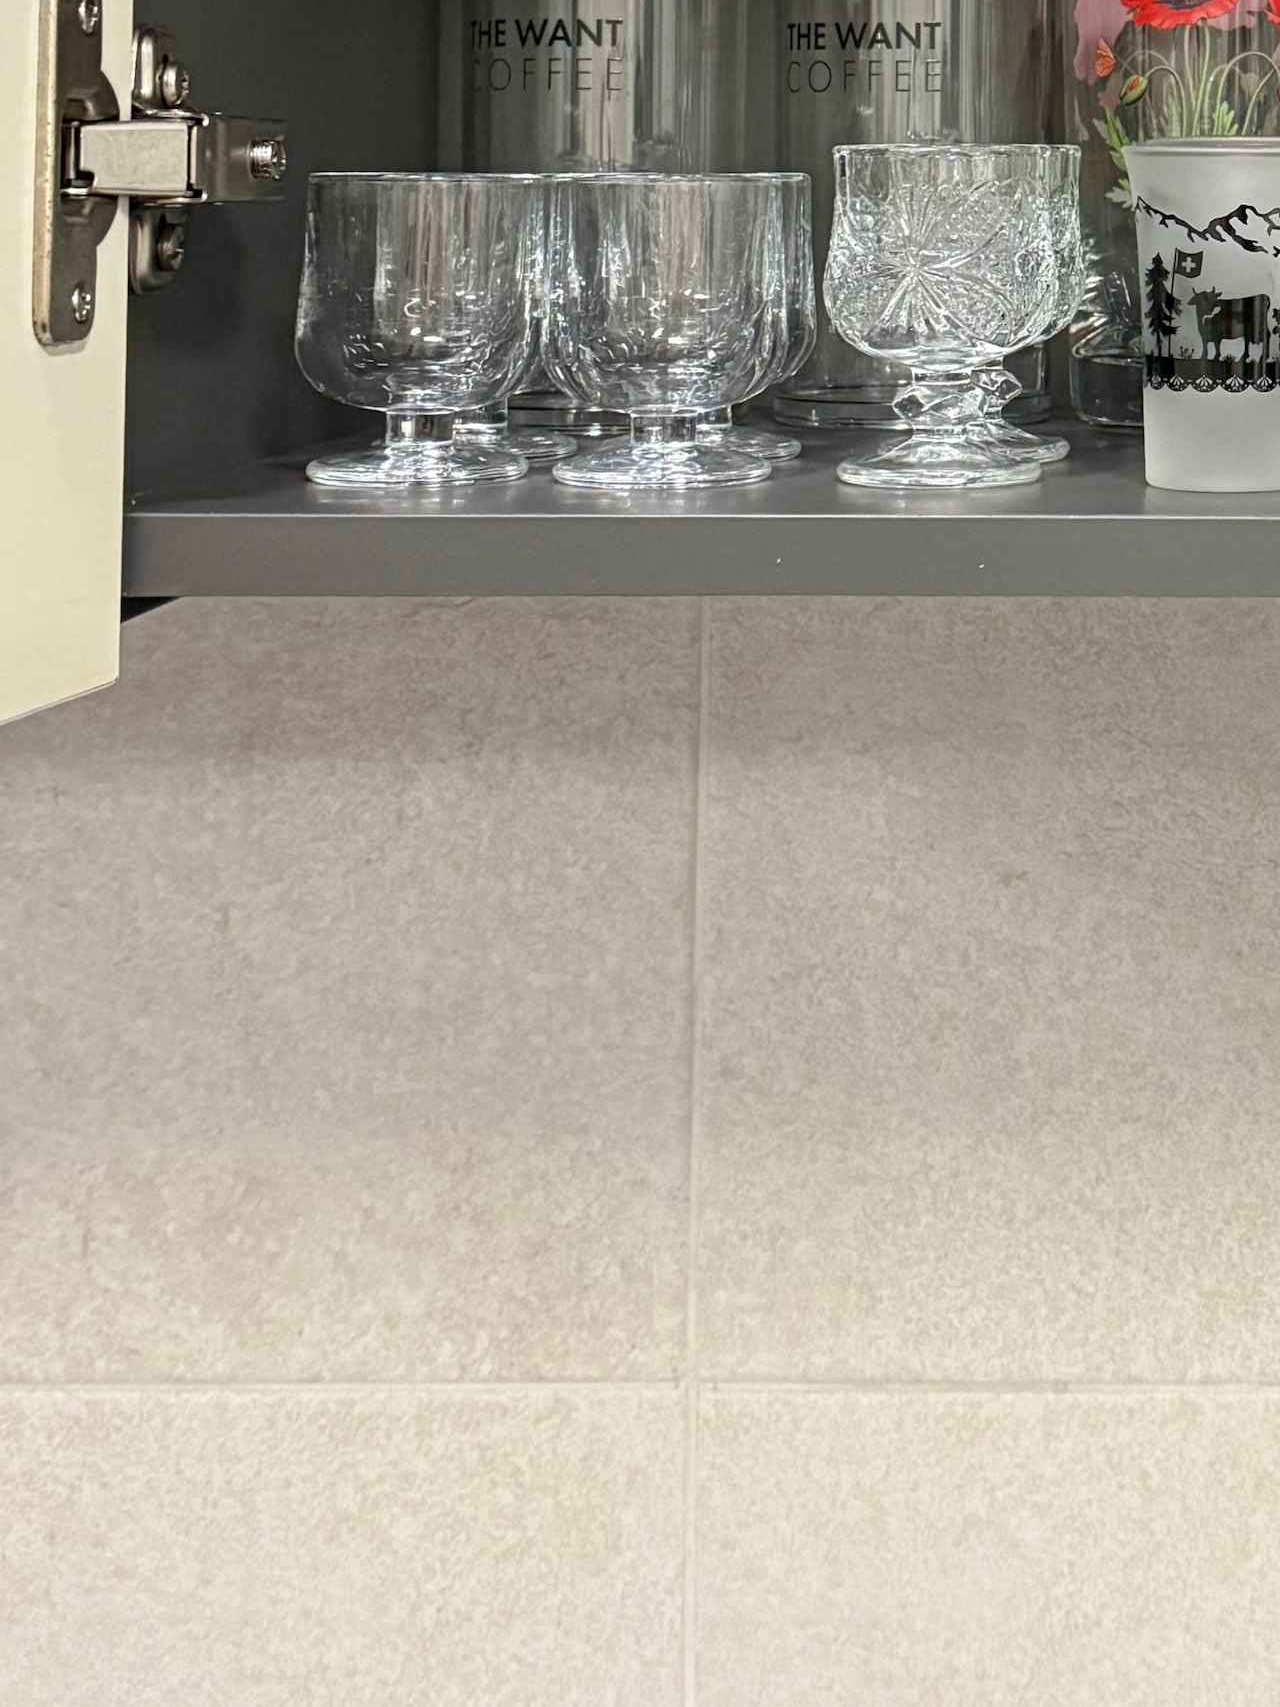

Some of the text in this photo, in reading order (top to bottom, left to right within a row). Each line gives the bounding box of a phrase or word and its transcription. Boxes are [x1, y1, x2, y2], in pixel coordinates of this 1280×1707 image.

[470, 18, 624, 49] THE WANT
[787, 21, 942, 51] THE WANT
[472, 57, 623, 92] COFFEE
[787, 60, 942, 93] COFFEE
